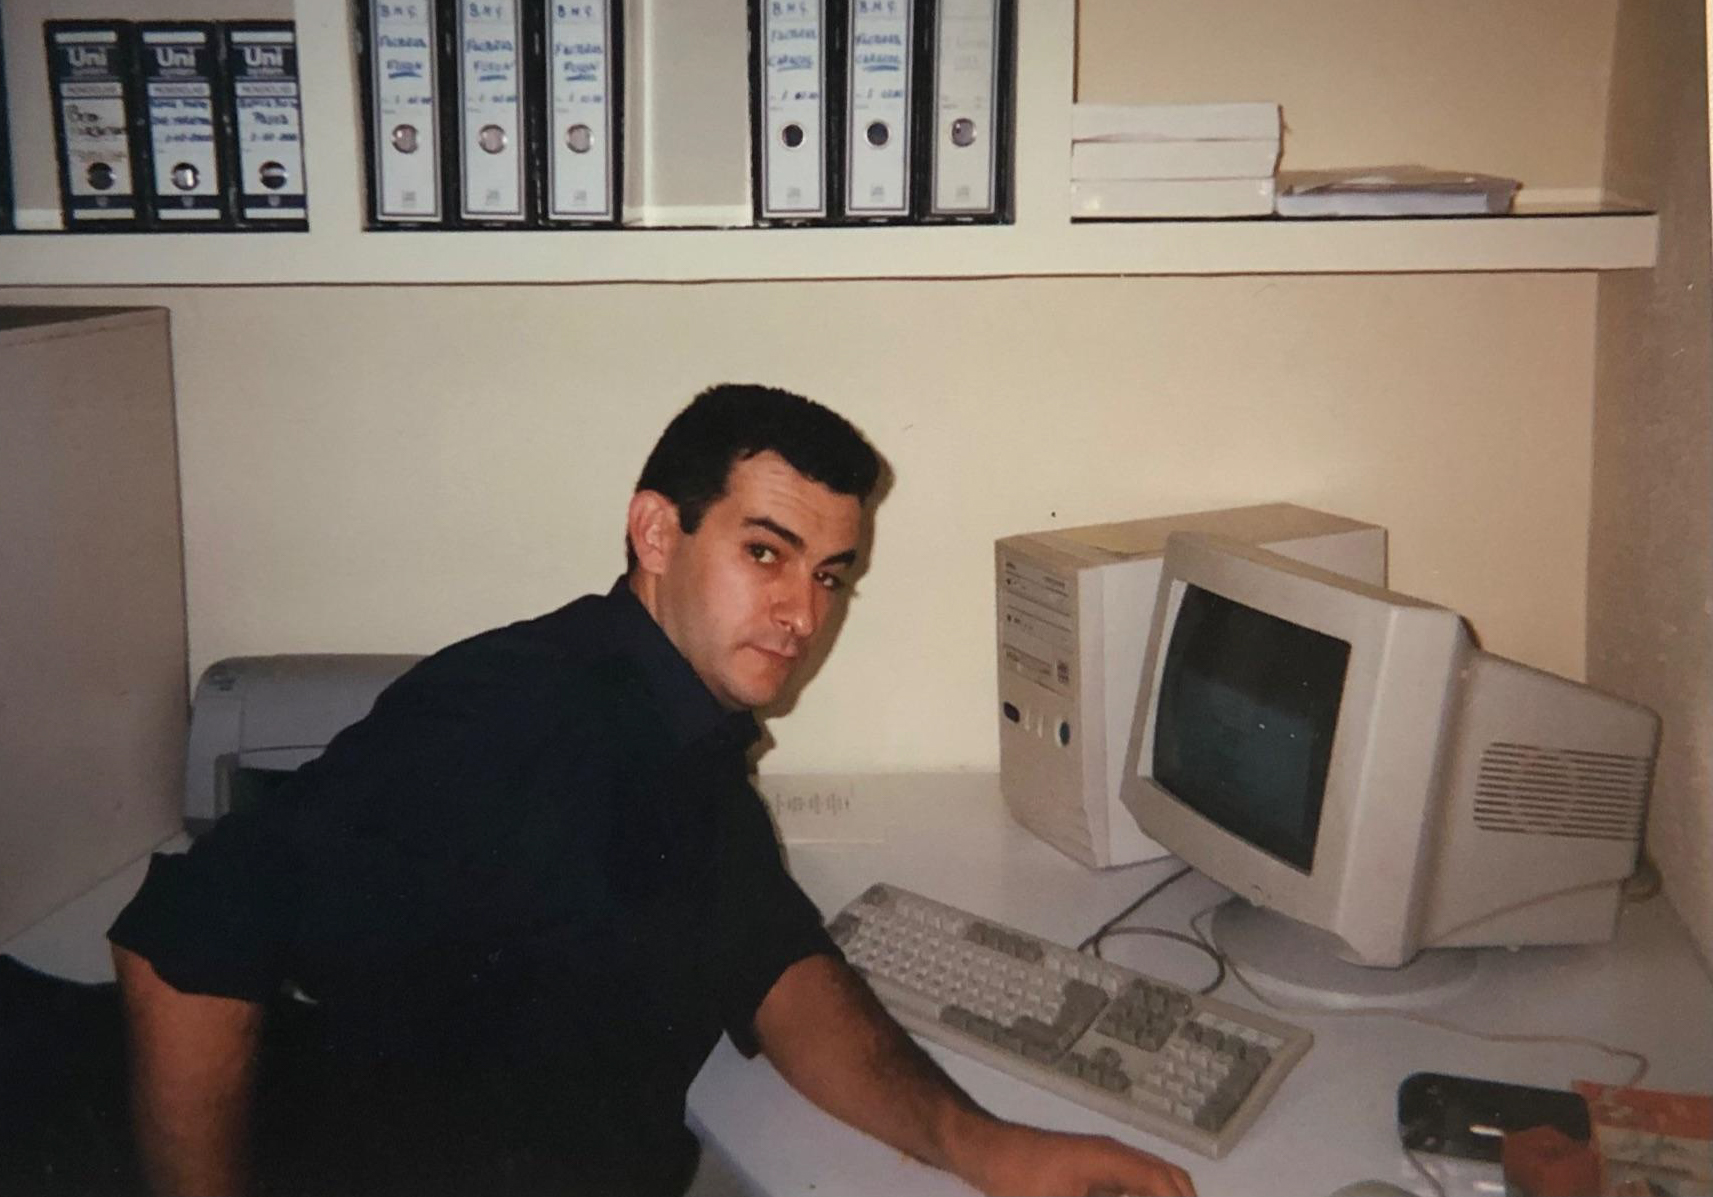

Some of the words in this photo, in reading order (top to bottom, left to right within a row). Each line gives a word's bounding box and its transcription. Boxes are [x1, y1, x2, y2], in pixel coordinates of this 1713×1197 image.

[68, 47, 107, 67] Uni
[156, 47, 196, 67] Uni
[244, 47, 284, 66] Uni
